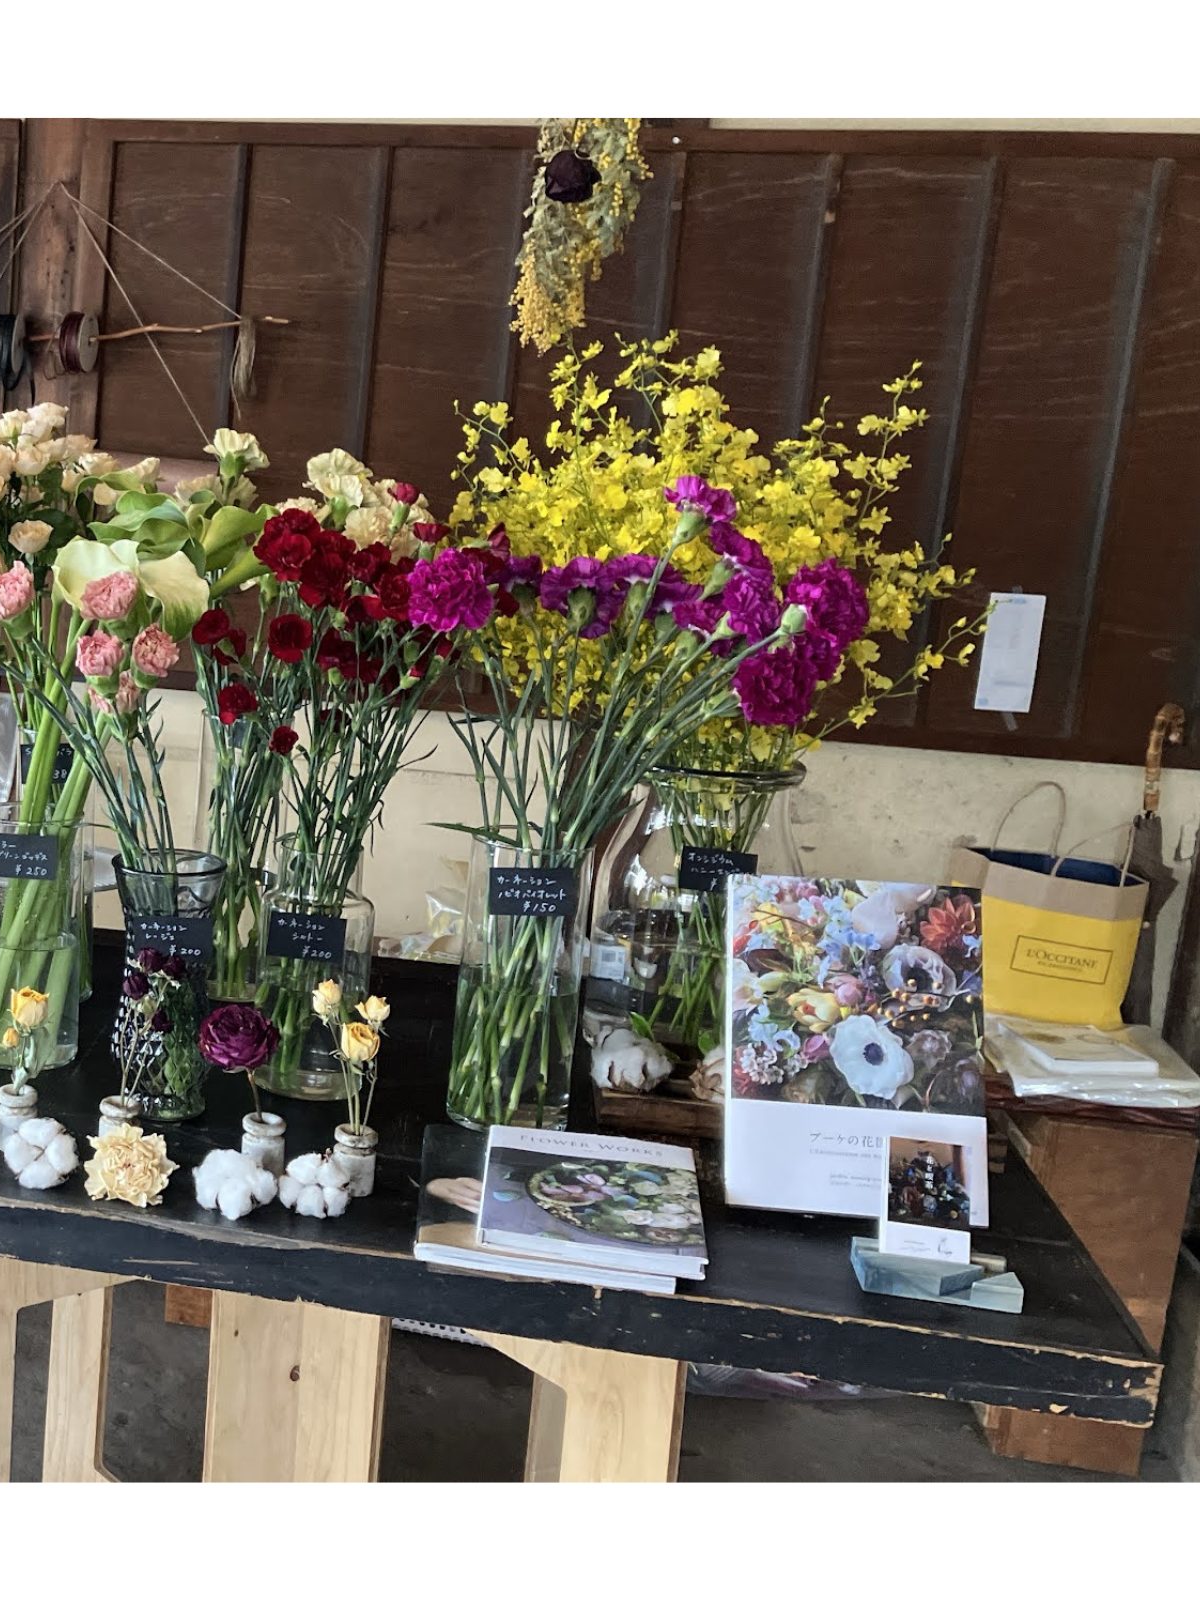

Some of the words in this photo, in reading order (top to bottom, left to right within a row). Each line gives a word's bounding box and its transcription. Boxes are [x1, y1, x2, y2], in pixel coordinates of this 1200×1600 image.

[497, 874, 556, 886] カーネーション
[520, 1135, 590, 1148] FLOWER
[599, 1143, 663, 1157] WORKS
